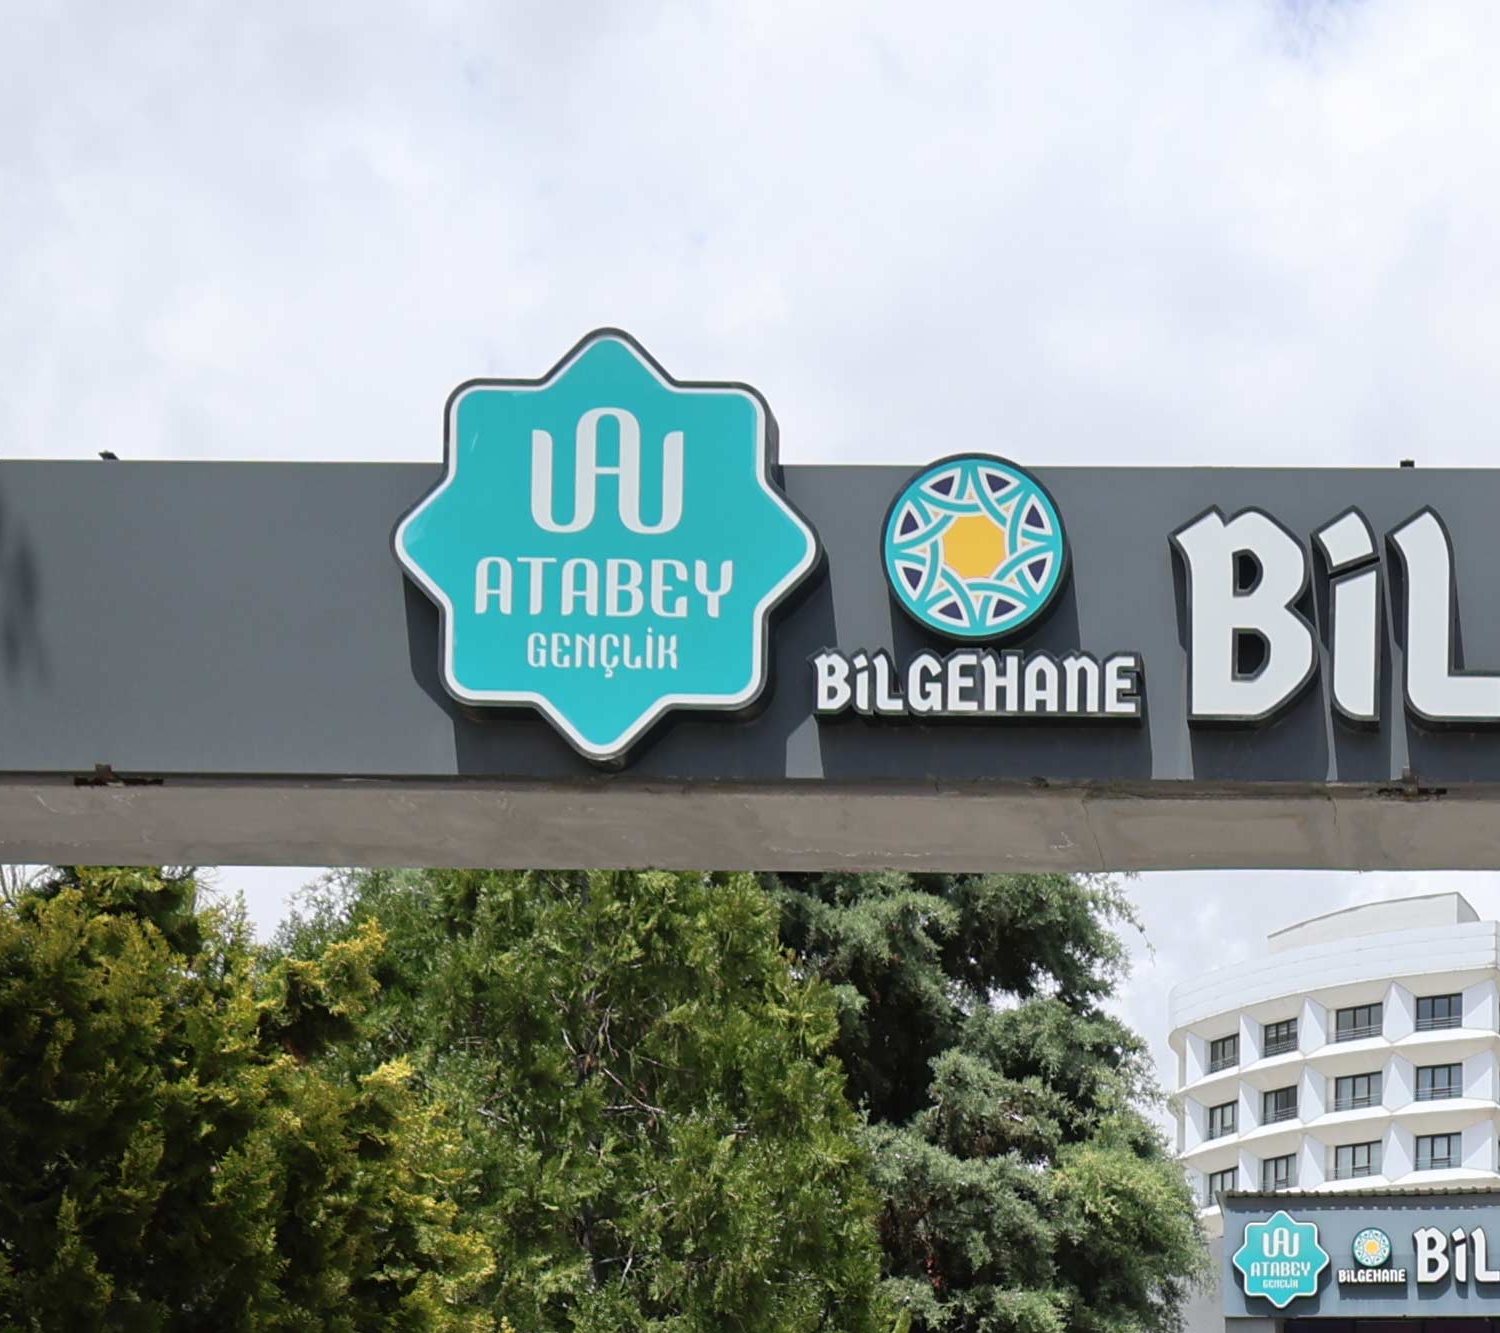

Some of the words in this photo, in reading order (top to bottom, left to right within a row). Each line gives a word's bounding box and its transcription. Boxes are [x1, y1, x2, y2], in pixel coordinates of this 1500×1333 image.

[474, 556, 734, 618] ATABEY
[527, 626, 678, 679] GENÇLİK
[1250, 1261, 1311, 1277] ATABEY
